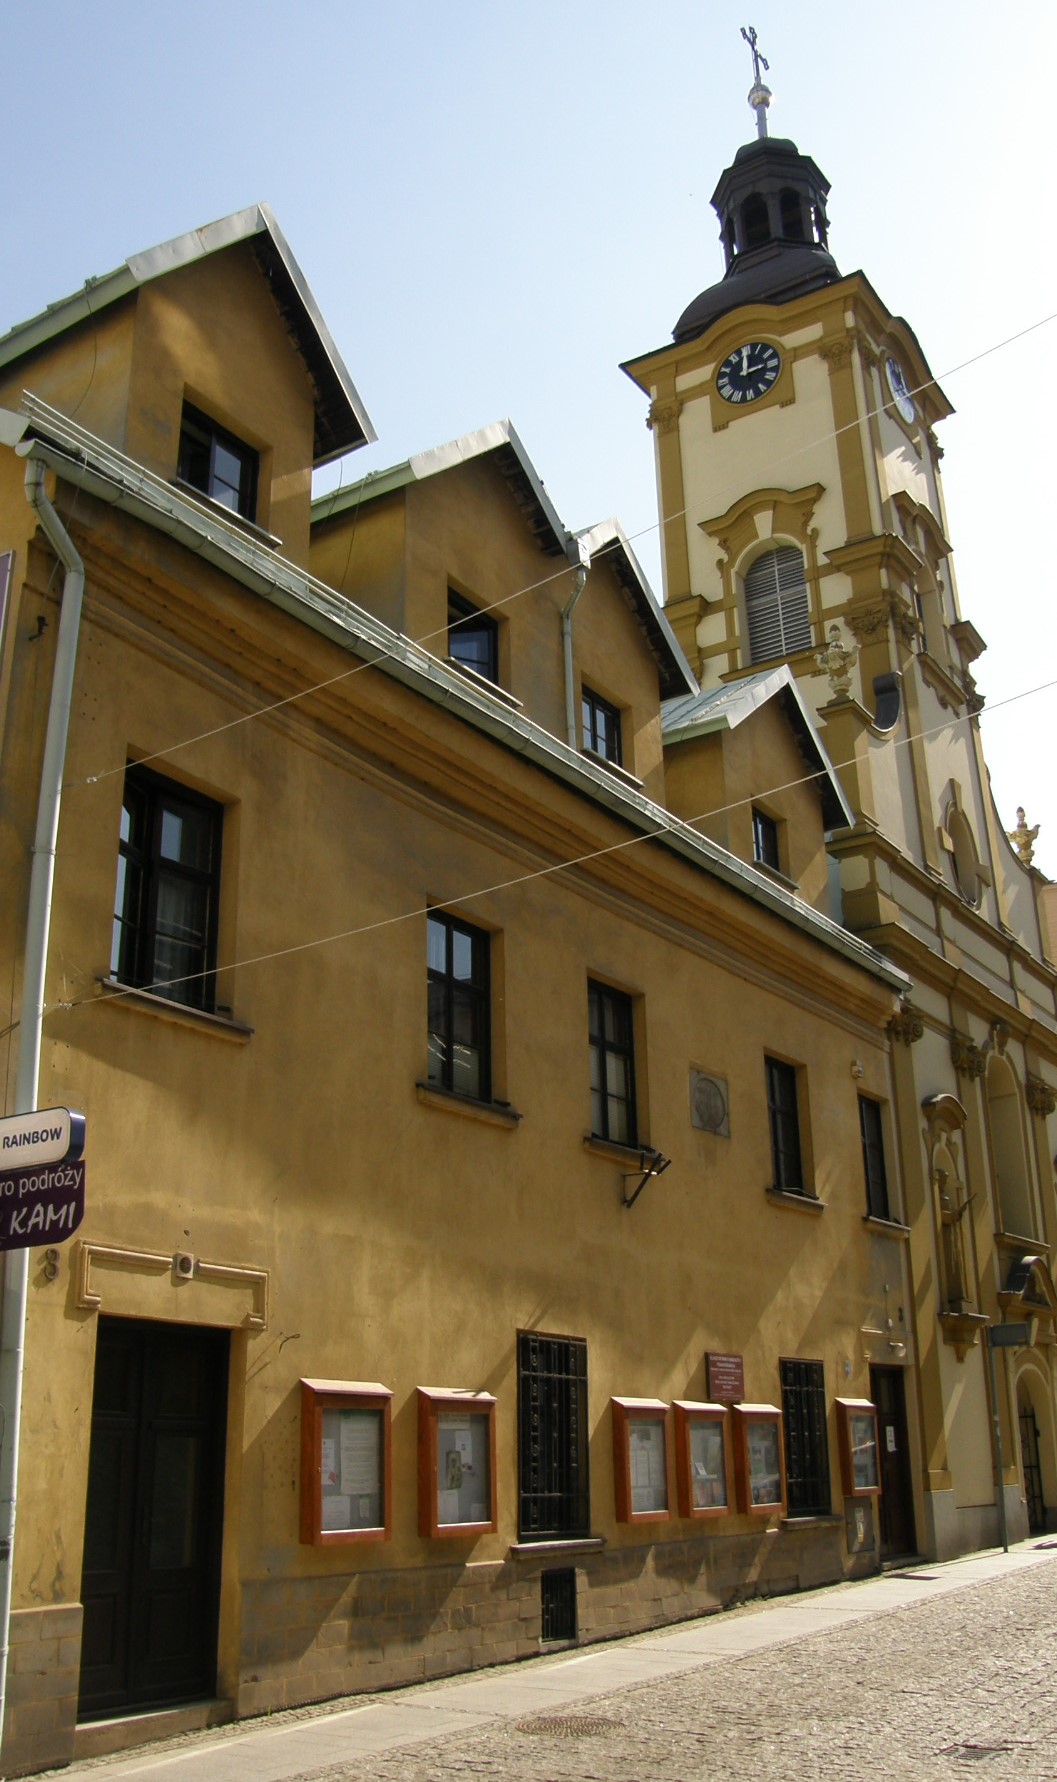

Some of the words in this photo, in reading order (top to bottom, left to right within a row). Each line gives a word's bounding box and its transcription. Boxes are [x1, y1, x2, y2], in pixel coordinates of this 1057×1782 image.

[3, 1127, 62, 1149] RAINBOW
[19, 1164, 83, 1198] podróży
[10, 1201, 76, 1235] KAMI
